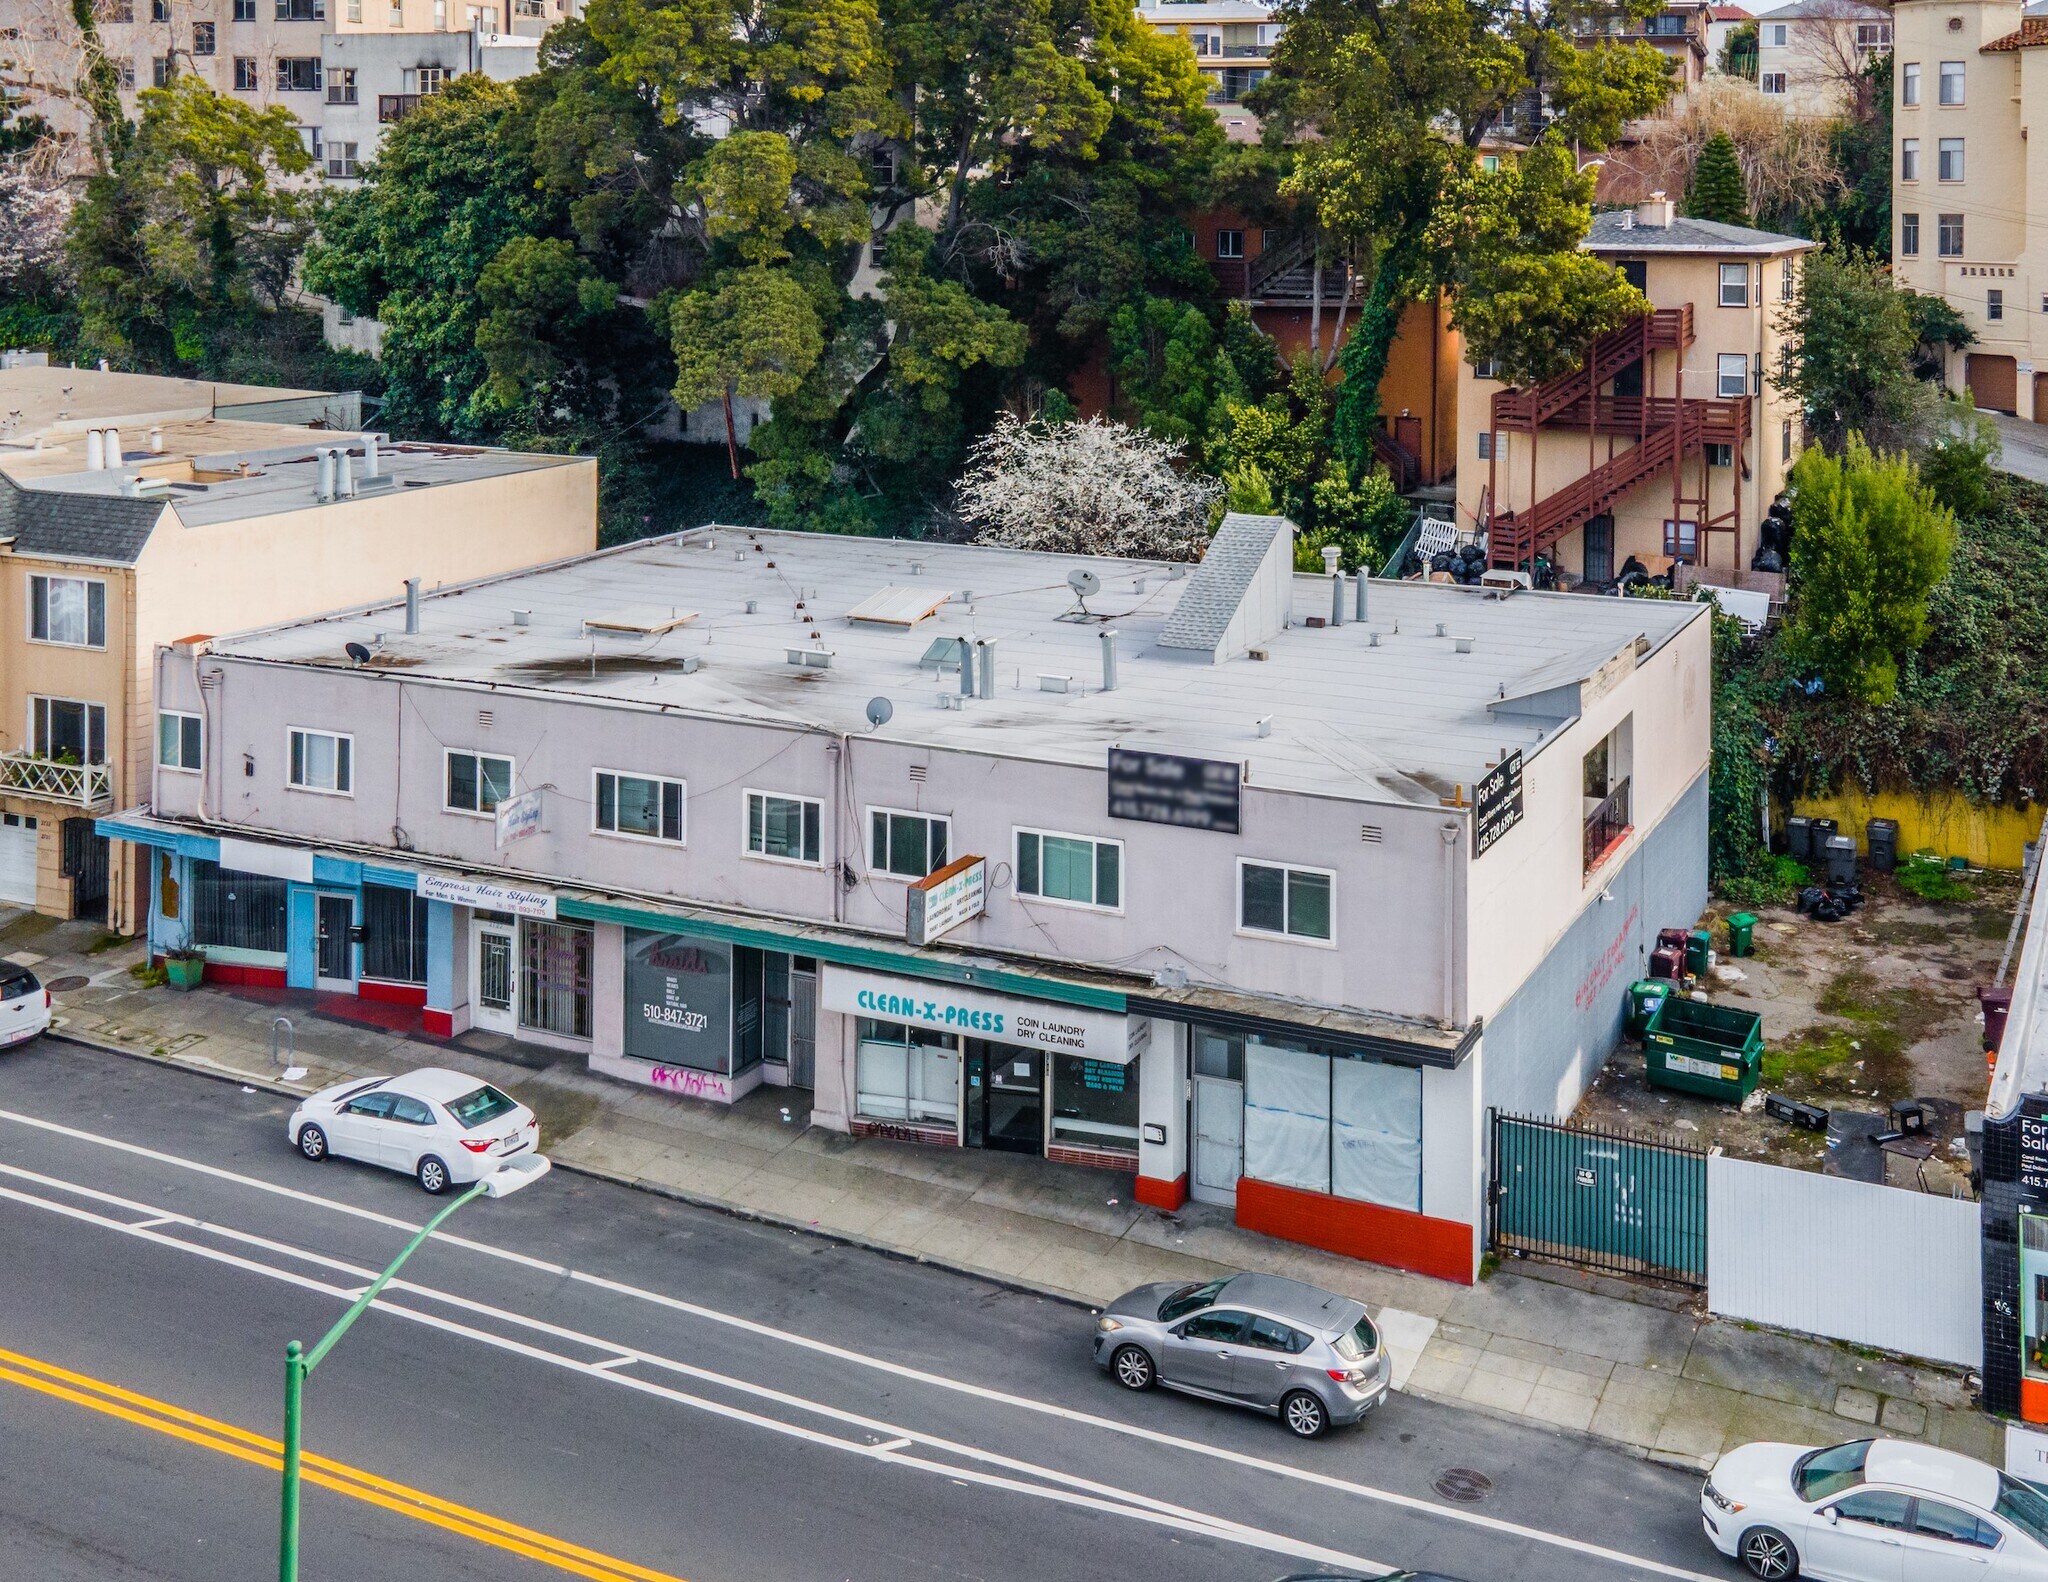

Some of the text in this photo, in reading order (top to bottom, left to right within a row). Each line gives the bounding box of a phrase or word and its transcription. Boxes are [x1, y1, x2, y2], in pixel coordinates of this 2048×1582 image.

[1479, 786, 1489, 806] For
[1490, 772, 1504, 795] Sale
[425, 876, 548, 908] Empress Hair Styling
[425, 889, 434, 897] For
[436, 891, 448, 899] Men
[457, 895, 477, 905] Women
[643, 1003, 708, 1029] 510-847-3721
[858, 990, 1004, 1033] CLEAN-X-PRESS
[1017, 1016, 1086, 1037] COIN LAUNDRY
[1017, 1028, 1085, 1049] DRY CLEANING
[2021, 1119, 2048, 1136] For
